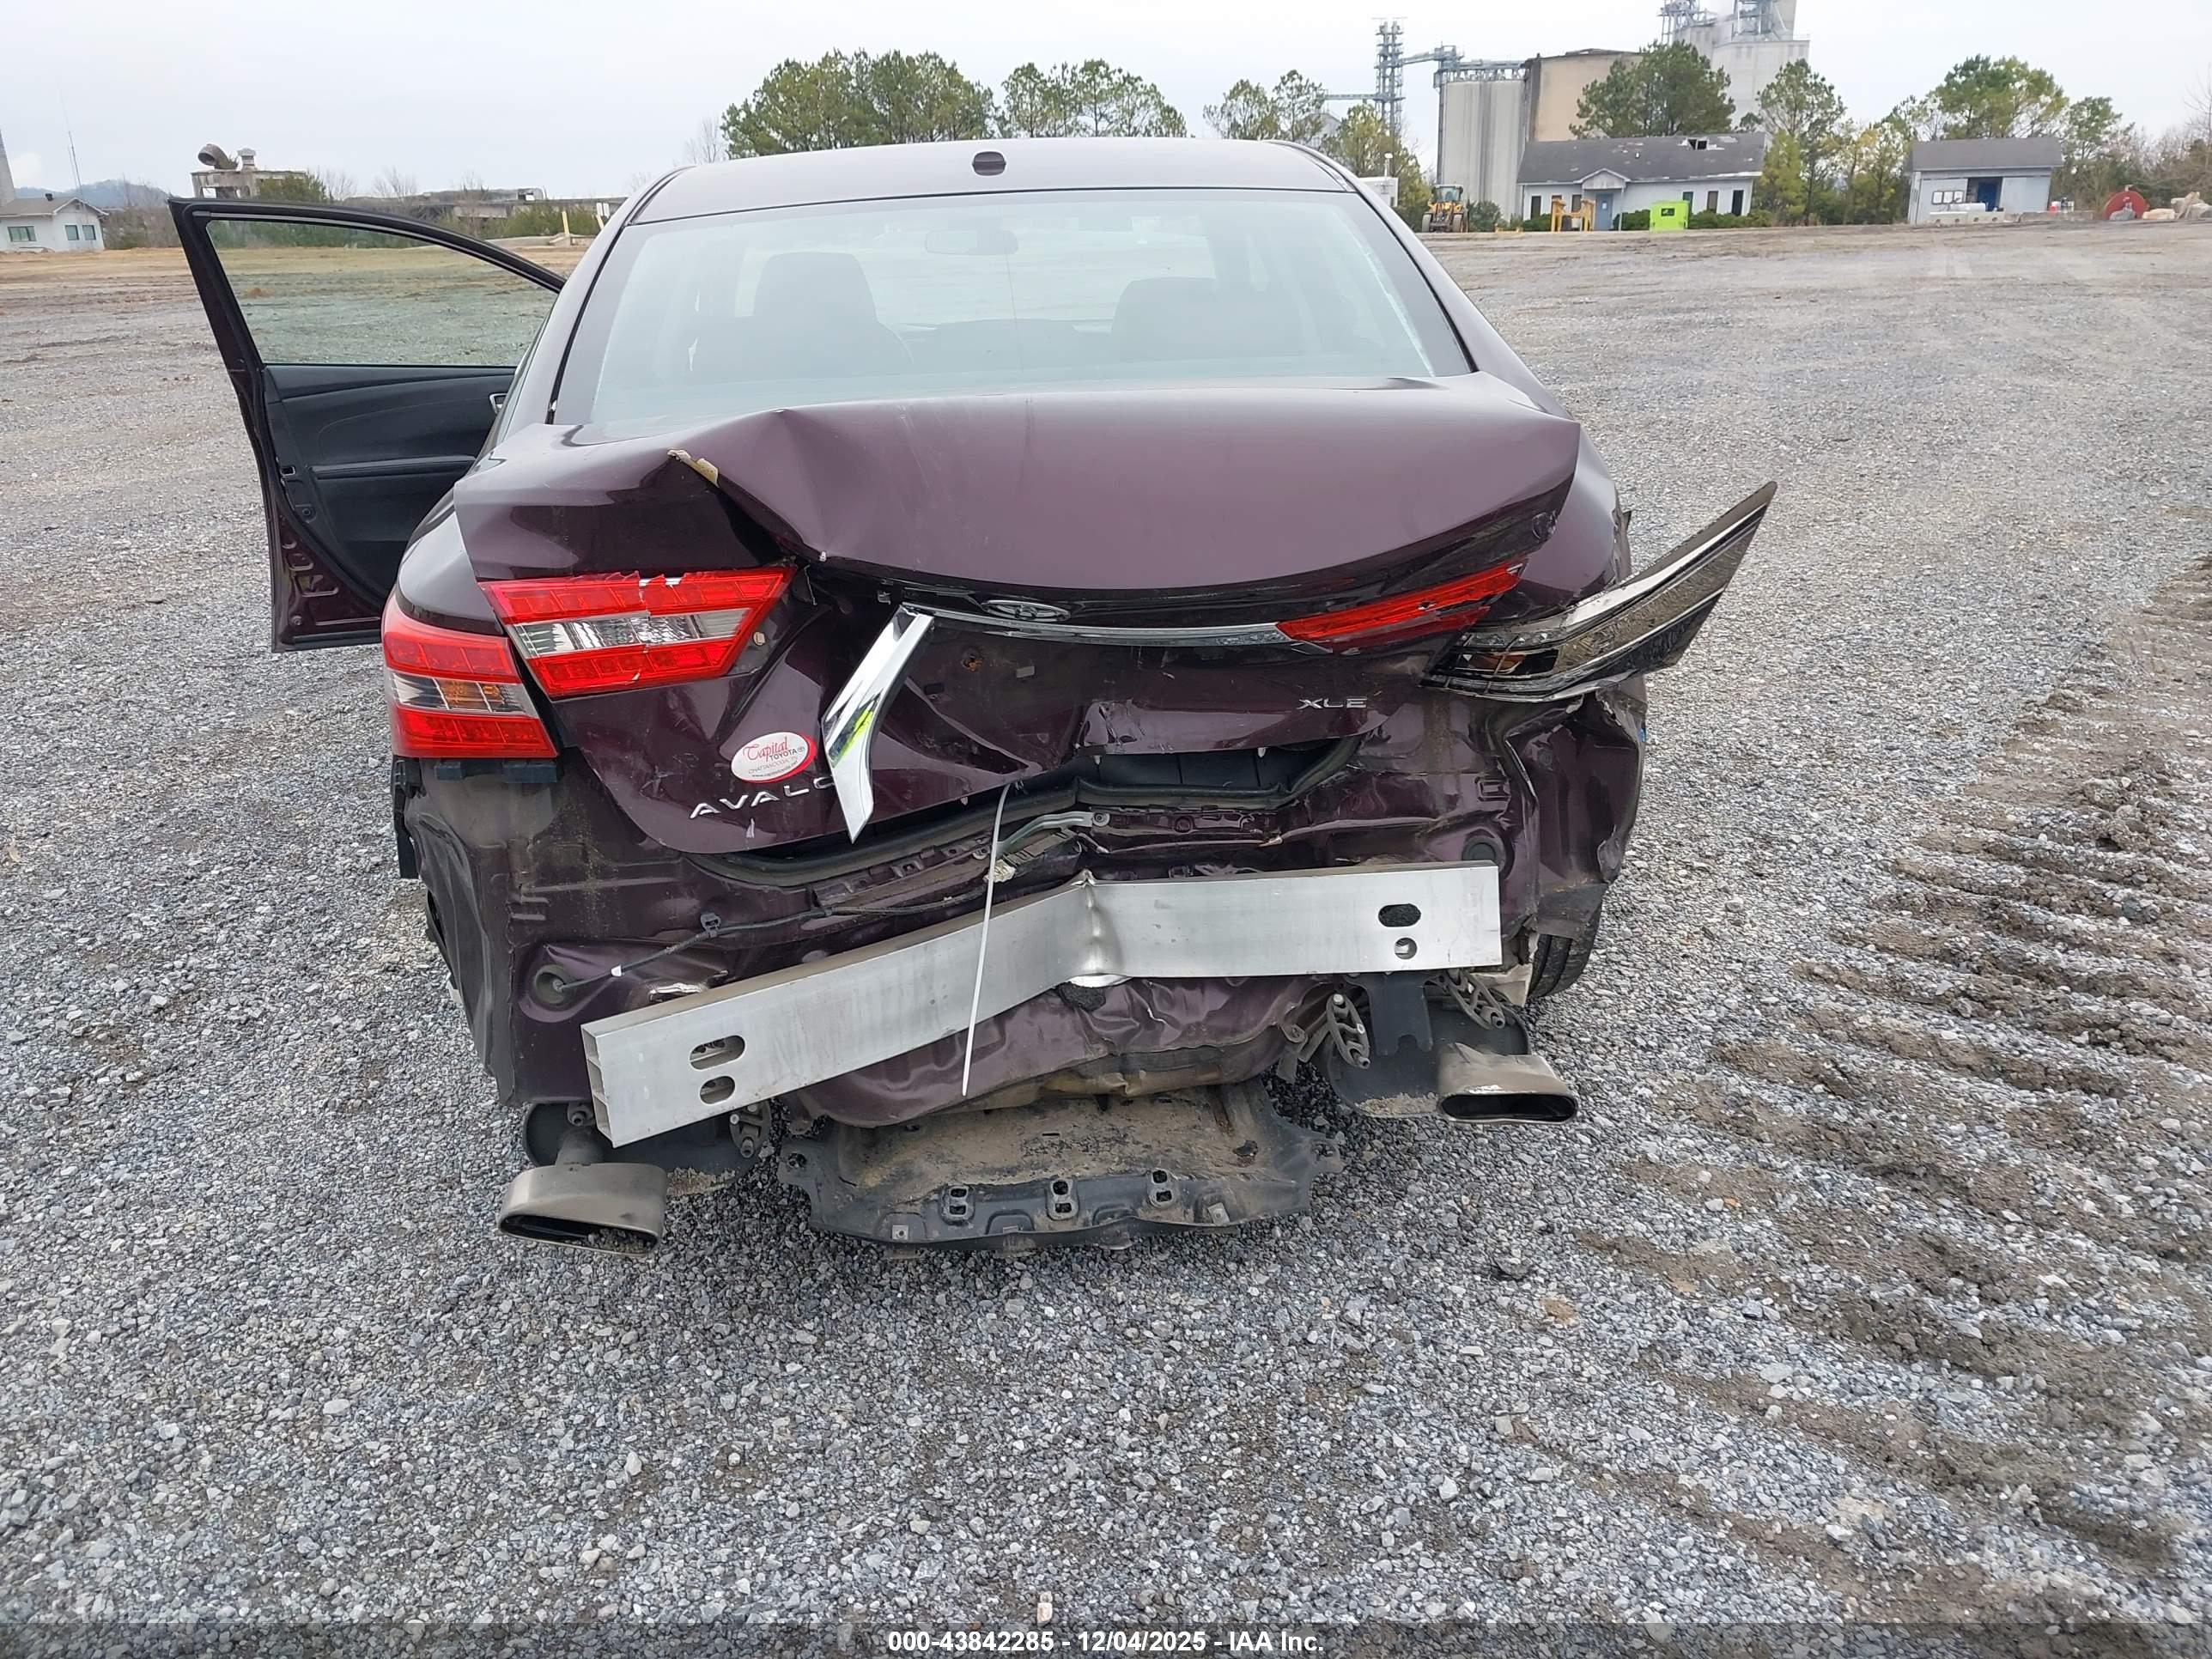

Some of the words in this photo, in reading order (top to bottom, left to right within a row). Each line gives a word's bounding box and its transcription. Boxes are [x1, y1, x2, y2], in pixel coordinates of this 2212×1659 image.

[1297, 697, 1367, 709] XLE
[743, 736, 788, 763] Capital
[769, 748, 798, 761] TOYOTA
[690, 776, 836, 819] AVALO
